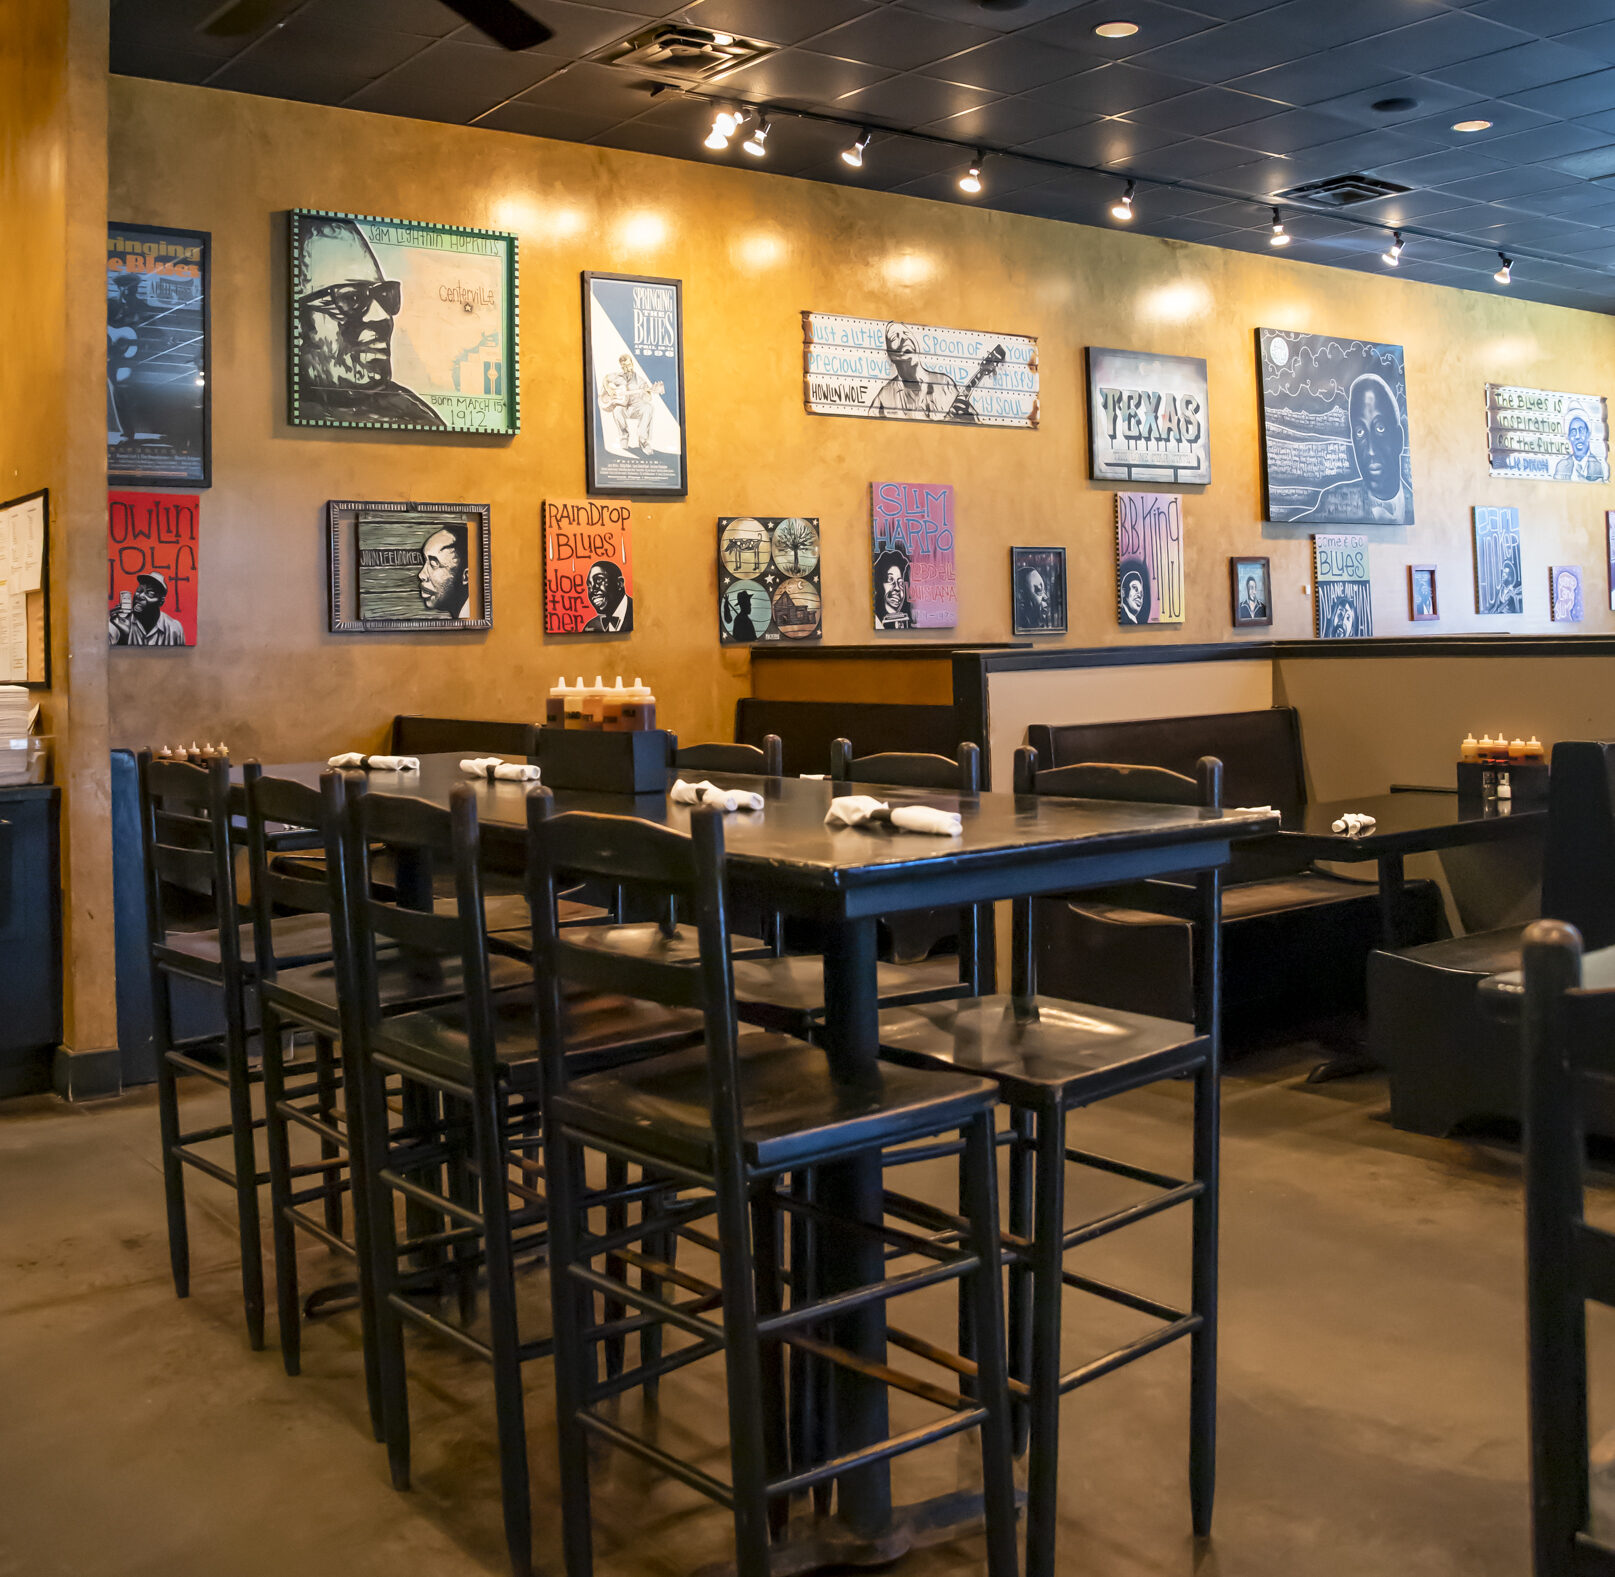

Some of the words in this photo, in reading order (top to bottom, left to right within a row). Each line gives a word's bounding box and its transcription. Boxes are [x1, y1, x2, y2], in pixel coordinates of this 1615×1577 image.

[369, 224, 390, 243] Sam
[126, 254, 200, 278] Blues
[633, 287, 673, 311] SPRINGING
[643, 309, 665, 317] THE
[633, 309, 675, 346] BLUES
[809, 322, 836, 343] Just
[841, 329, 849, 344] a
[922, 334, 964, 354] Spoon
[843, 385, 868, 403] WOLF
[451, 410, 487, 427] 1912
[1100, 387, 1200, 444] TEXAS
[877, 483, 948, 527] SLIM
[873, 518, 954, 554] HARPO
[1141, 496, 1181, 618] King
[548, 569, 585, 594] Joe
